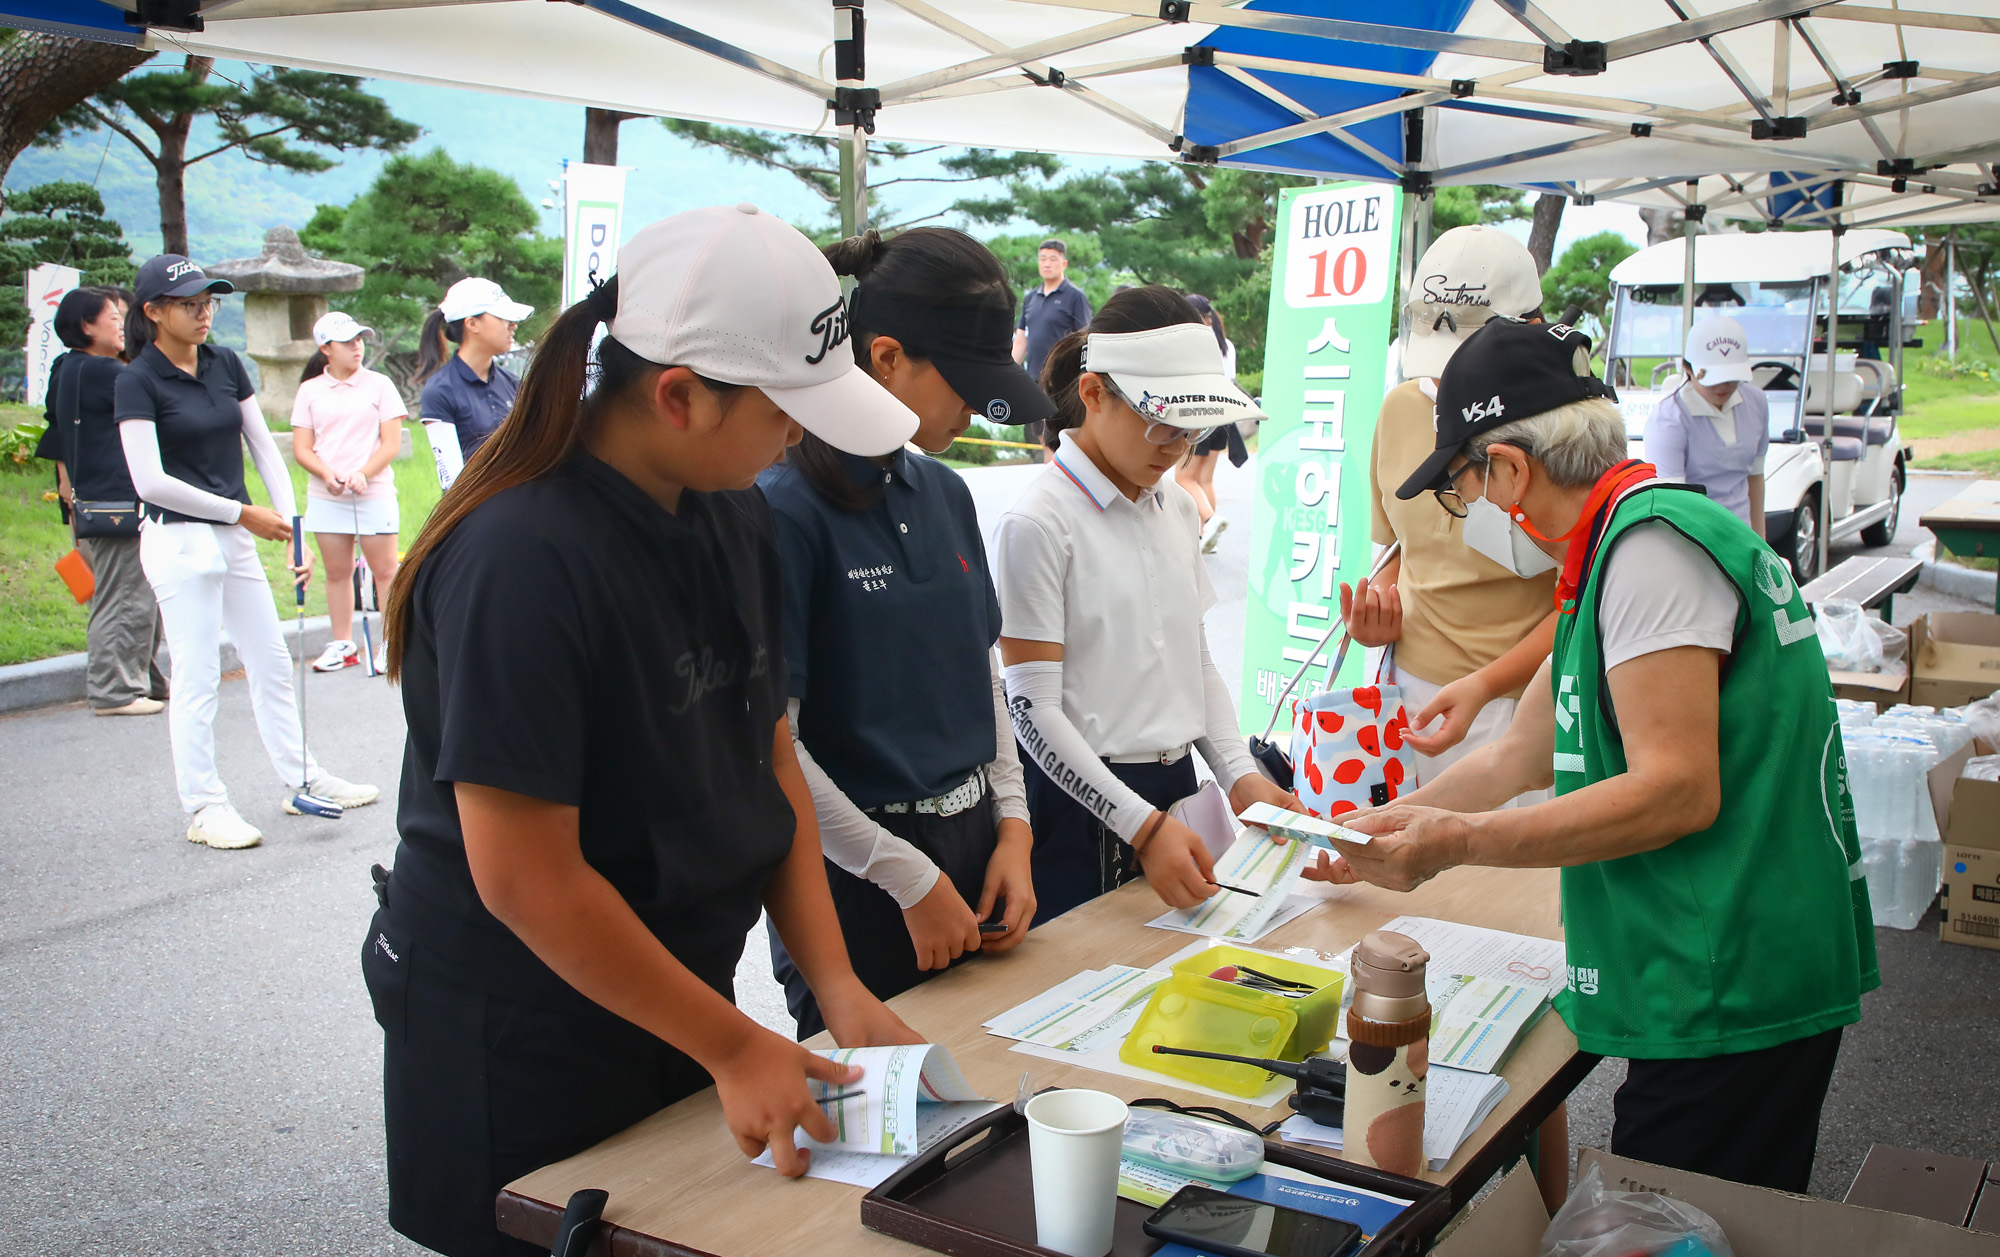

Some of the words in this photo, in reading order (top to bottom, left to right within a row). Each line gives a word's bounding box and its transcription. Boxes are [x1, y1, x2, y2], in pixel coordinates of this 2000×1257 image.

[1302, 196, 1380, 239] HOLE
[1306, 247, 1367, 298] 10
[1705, 336, 1742, 351] Callaway
[1178, 408, 1225, 418] EDITION
[1208, 395, 1249, 409] BUNNY
[1461, 395, 1505, 423] VS4
[1282, 317, 1351, 668] 스코어카드
[1043, 751, 1117, 822] GARMENT
[1956, 852, 1981, 861] LOTTE
